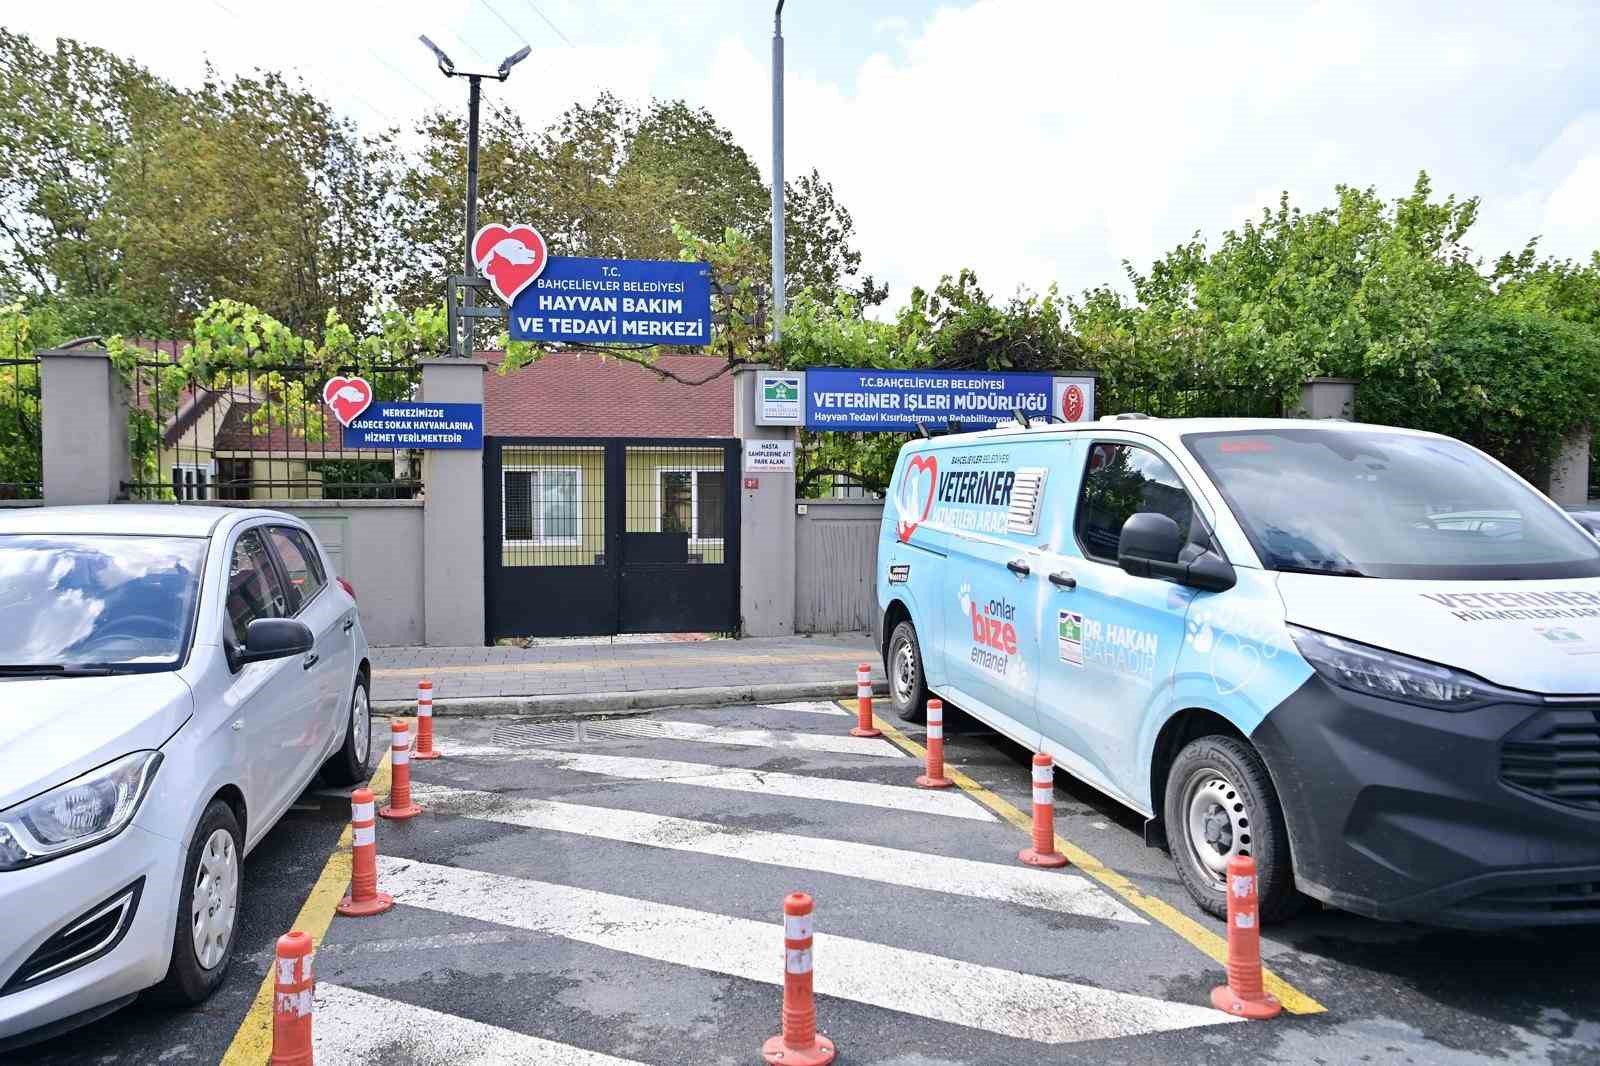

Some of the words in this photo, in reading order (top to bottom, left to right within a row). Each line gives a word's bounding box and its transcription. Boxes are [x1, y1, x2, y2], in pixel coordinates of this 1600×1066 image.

[602, 266, 621, 277] T.C.
[537, 279, 620, 291] BAHÇELİEVLER
[623, 281, 685, 293] BELEDİYESİ
[539, 296, 617, 313] HAYVAN
[623, 298, 682, 314] BAKIM
[518, 317, 544, 333] VE
[549, 316, 616, 335] TEDAVİ
[623, 318, 703, 337] MERKEZİ
[950, 378, 1005, 390] BELEDİYESİ
[813, 391, 900, 409] VETERİNER
[904, 393, 951, 412] İŞLERİ
[954, 391, 1048, 411] MÜDÜRLÜĞÜ
[382, 408, 444, 418] MERKEZİMİZDE
[814, 411, 848, 423] Hayvan
[849, 412, 879, 422] Tedavi
[880, 412, 935, 424] Kısırlaştırma
[937, 415, 948, 423] ve
[352, 421, 383, 429] SADECE
[385, 421, 412, 430] SOKAK
[413, 421, 474, 431] HAYVANLARINA
[365, 432, 397, 442] HİZMET
[398, 432, 462, 443] VERİLMEKTEDİR
[938, 470, 1015, 506] VETERİNER
[990, 597, 1016, 621] onlar
[971, 601, 1017, 655] bize
[1105, 623, 1158, 656] HAKAN
[971, 645, 1009, 675] emanet
